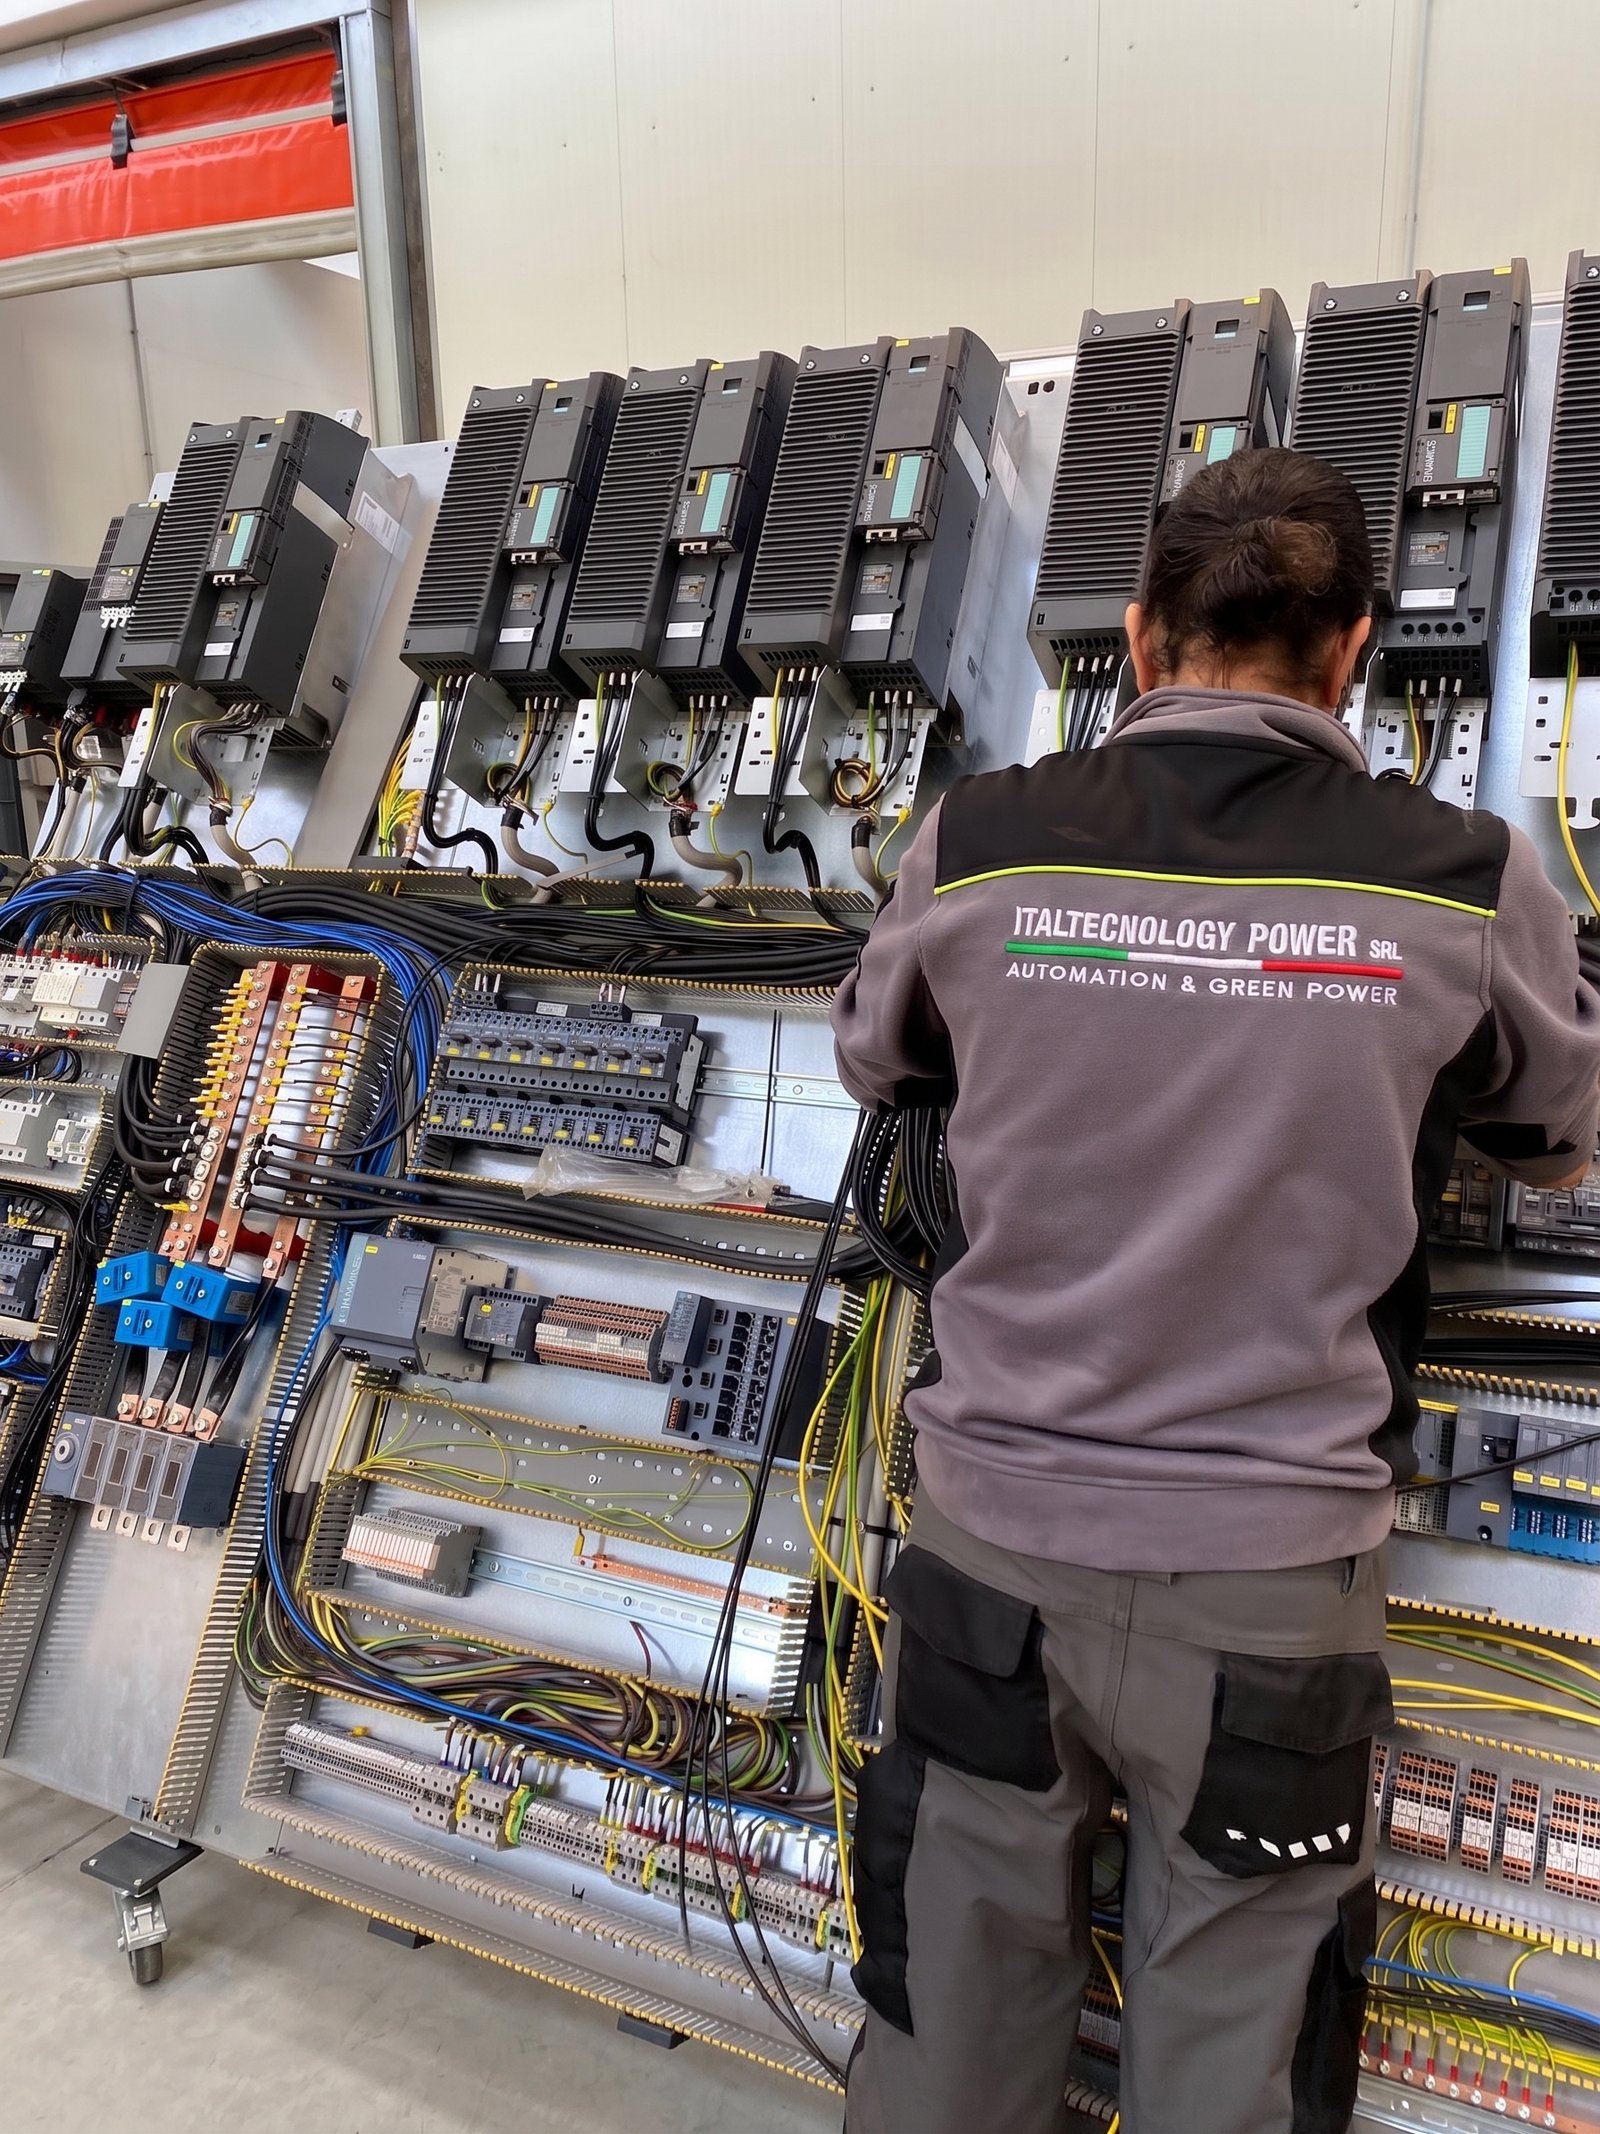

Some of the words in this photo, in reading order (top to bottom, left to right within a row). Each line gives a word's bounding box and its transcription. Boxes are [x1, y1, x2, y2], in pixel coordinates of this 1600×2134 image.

[1014, 906, 1236, 952] ITALTECNOLOGY
[1248, 922, 1357, 957] POWER
[1369, 939, 1403, 961] SRL
[1005, 961, 1167, 991] AUTOMATION
[1181, 975, 1197, 994] &
[1208, 977, 1294, 1000] GREEN
[1306, 983, 1398, 1006] POWER
